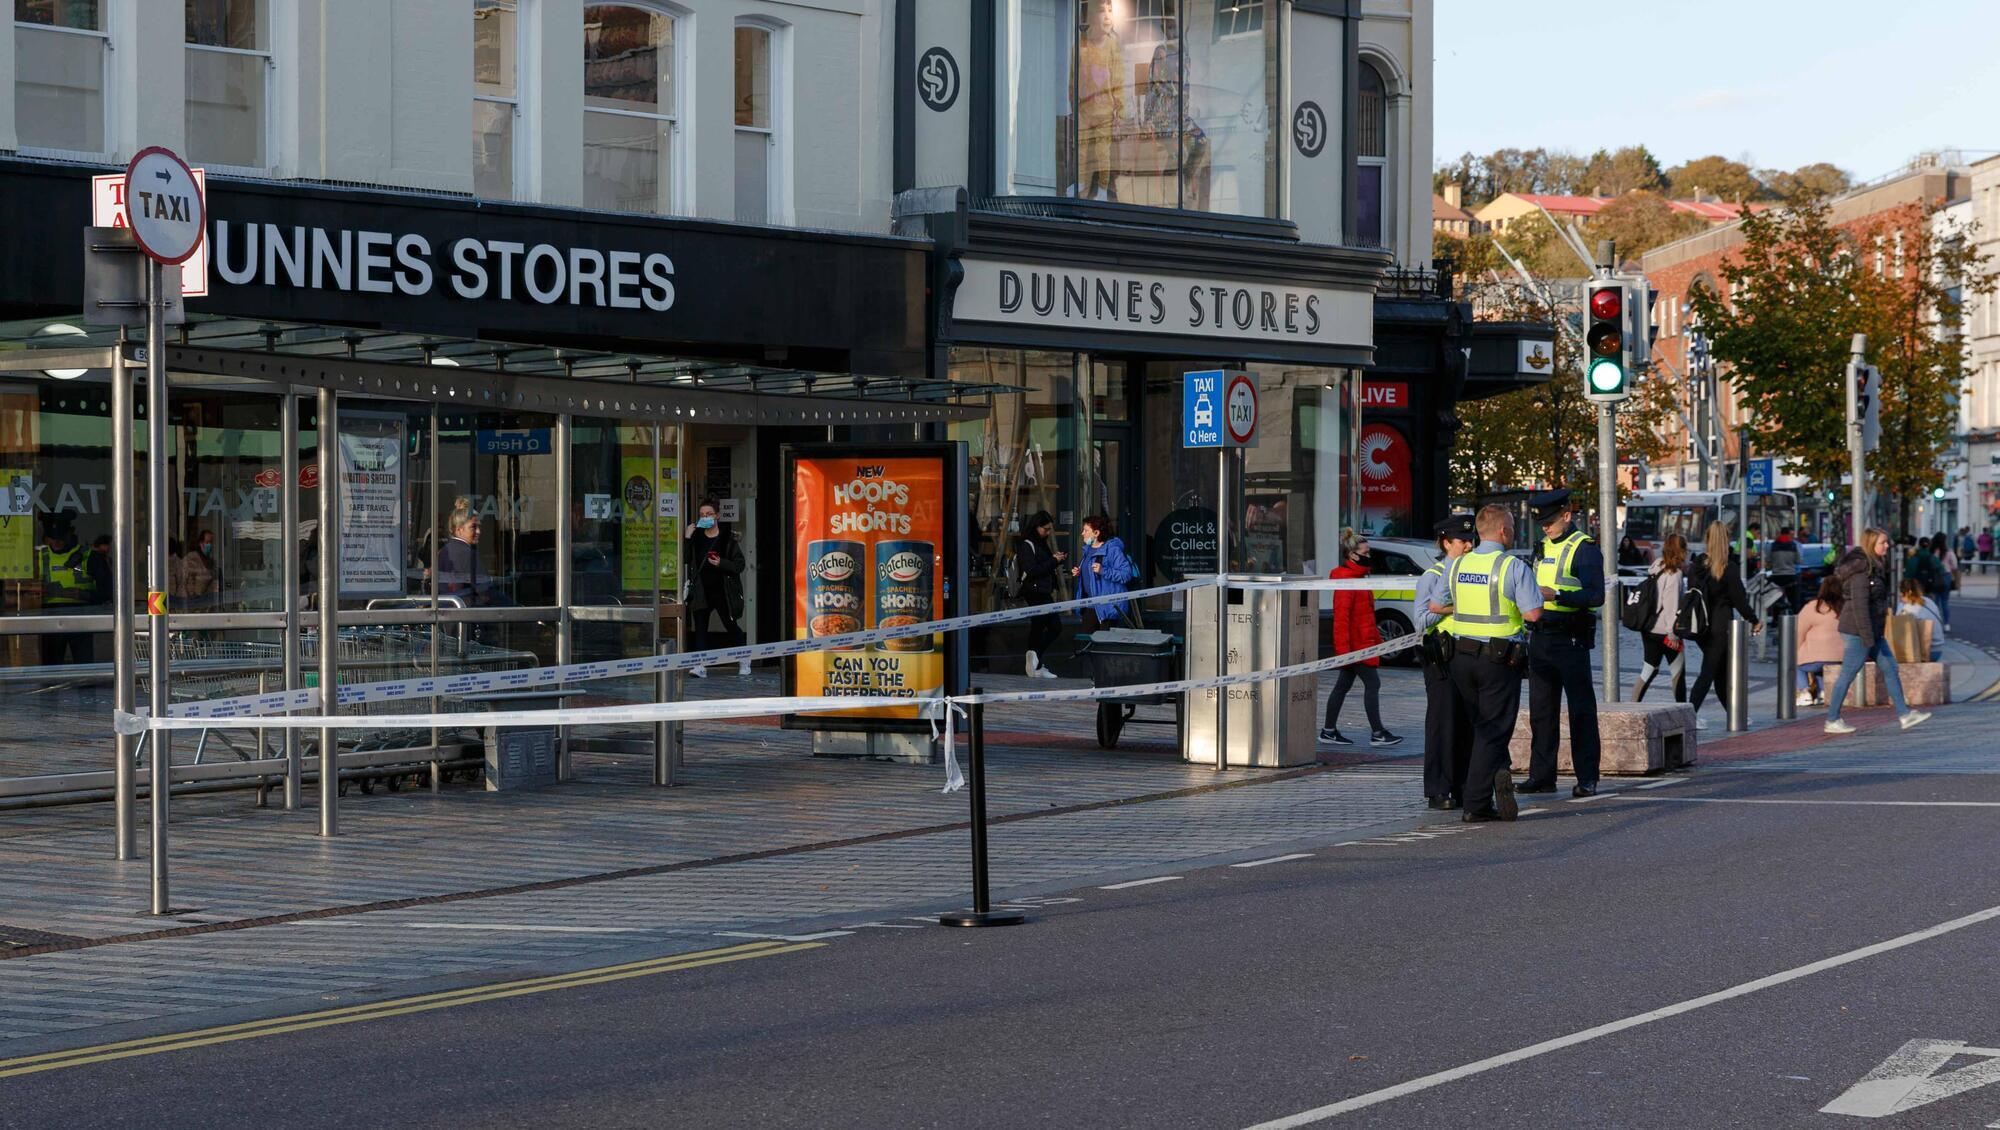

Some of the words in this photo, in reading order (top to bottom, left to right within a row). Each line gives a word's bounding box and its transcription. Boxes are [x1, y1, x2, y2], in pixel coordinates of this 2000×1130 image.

[139, 191, 191, 223] TAXI
[205, 219, 434, 296] UNNES
[451, 237, 676, 312] STORES
[999, 269, 1166, 324] DUNNES
[1188, 284, 1321, 336] STORES
[1193, 377, 1214, 393] TAXI
[1230, 404, 1252, 422] TAXI
[1189, 430, 1197, 444] Q
[1198, 430, 1217, 443] Here
[856, 465, 885, 478] NEW
[833, 479, 910, 507] HOOPS
[366, 504, 390, 512] TRAVEL
[867, 503, 875, 512] &
[830, 511, 912, 535] SHORTS
[1171, 522, 1204, 535] Click
[1207, 522, 1216, 535] &
[1169, 538, 1217, 551] Collect
[1459, 574, 1488, 584] GARDA
[814, 592, 859, 609] HOOPS
[880, 593, 928, 610] SHORTS
[1214, 613, 1253, 624] LTTER
[833, 656, 863, 672] CAN
[869, 657, 900, 672] YOU
[826, 672, 871, 686] TASTE
[875, 672, 904, 687] THE
